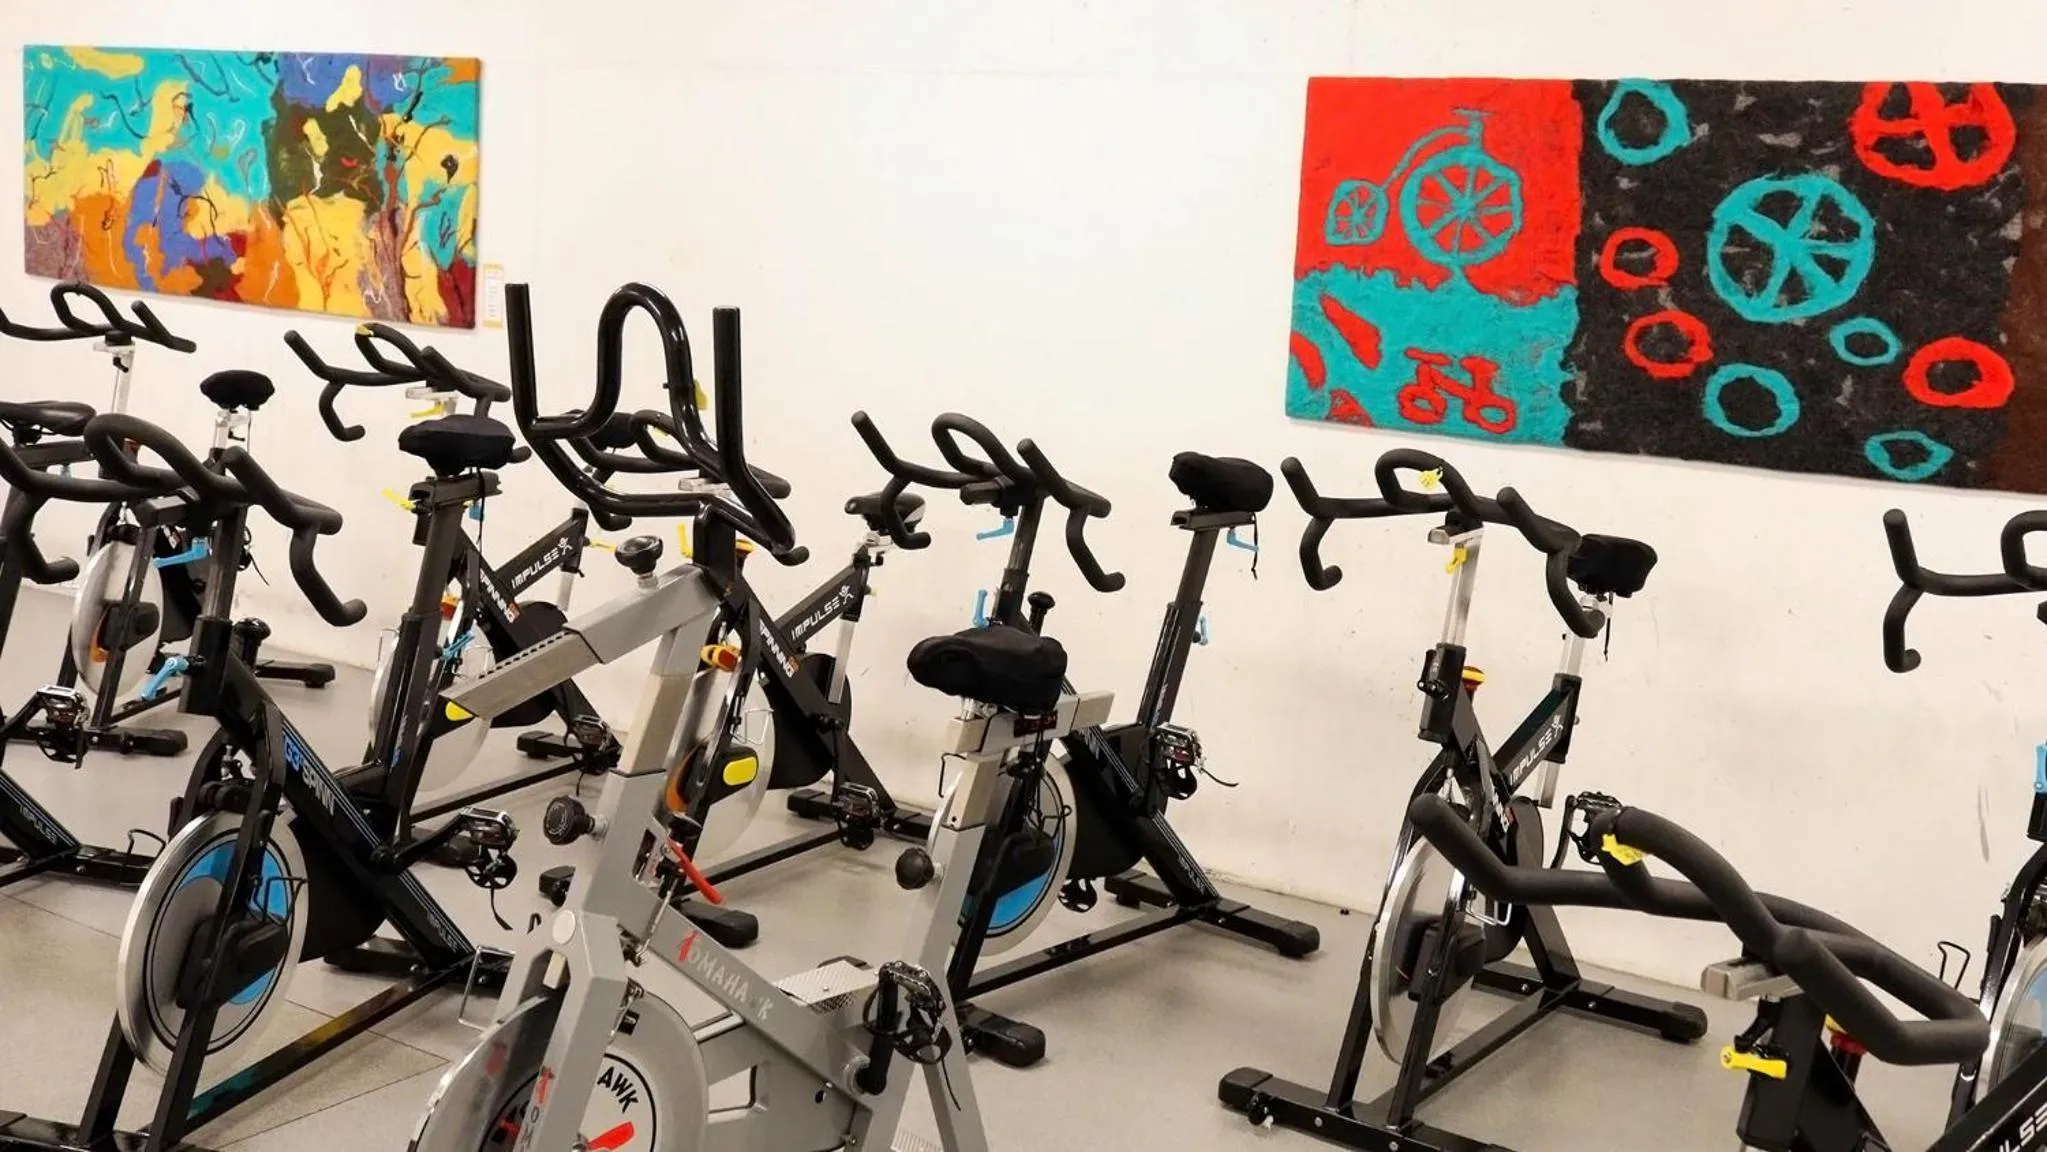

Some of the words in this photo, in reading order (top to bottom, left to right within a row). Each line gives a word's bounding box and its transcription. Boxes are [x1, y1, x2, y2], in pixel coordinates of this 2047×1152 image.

[511, 547, 560, 590] IMPULSE
[791, 596, 840, 641] IMPULSE
[1510, 727, 1553, 786] IMPULSE
[678, 929, 774, 1021] TOMAHAK
[1998, 1101, 2047, 1152] LSE
